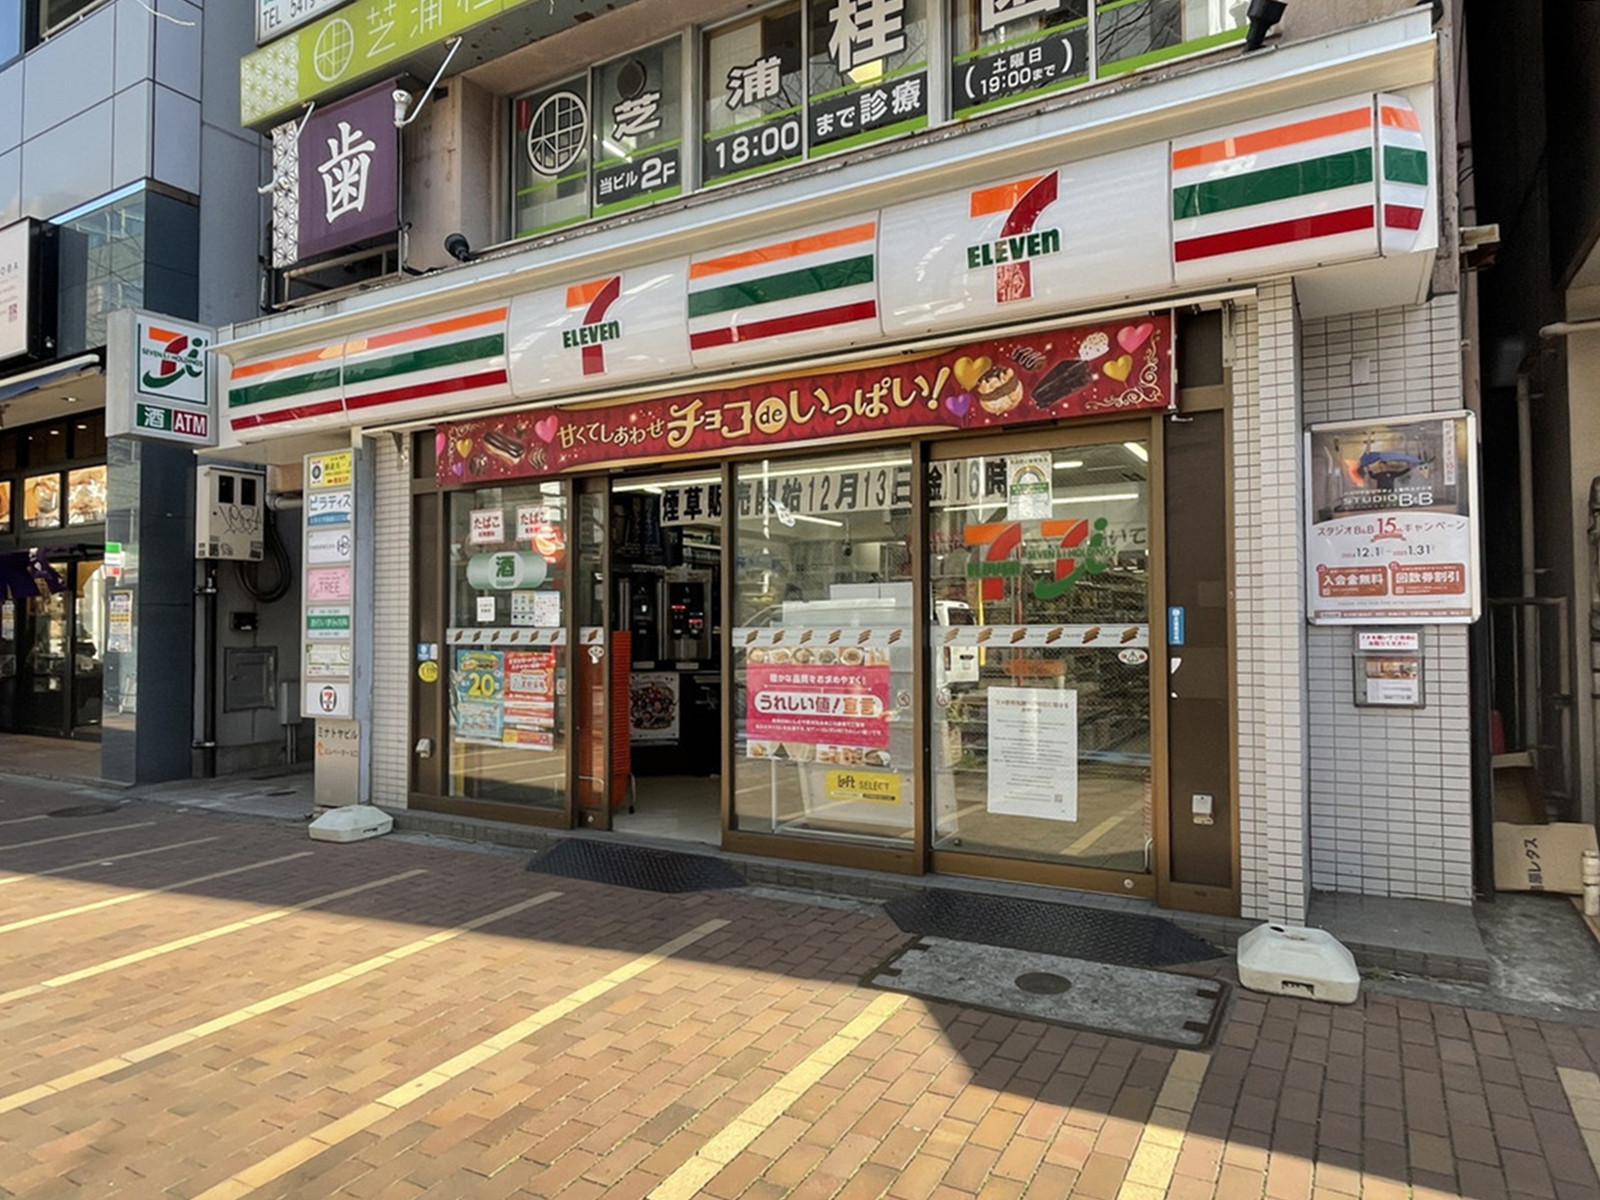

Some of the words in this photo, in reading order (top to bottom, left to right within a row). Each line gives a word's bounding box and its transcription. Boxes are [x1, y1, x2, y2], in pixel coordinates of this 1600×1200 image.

[263, 5, 282, 31] TEL
[366, 0, 494, 58] 芝浦
[715, 119, 801, 169] 18:00
[816, 78, 922, 137] まで診療
[316, 120, 376, 224] 歯
[144, 406, 165, 428] 酒
[173, 413, 206, 436] ATM
[309, 493, 352, 512] ピラティス
[473, 516, 501, 531] たばこ
[519, 511, 549, 526] たばこ
[496, 555, 516, 578] 酒
[467, 671, 497, 697] 20
